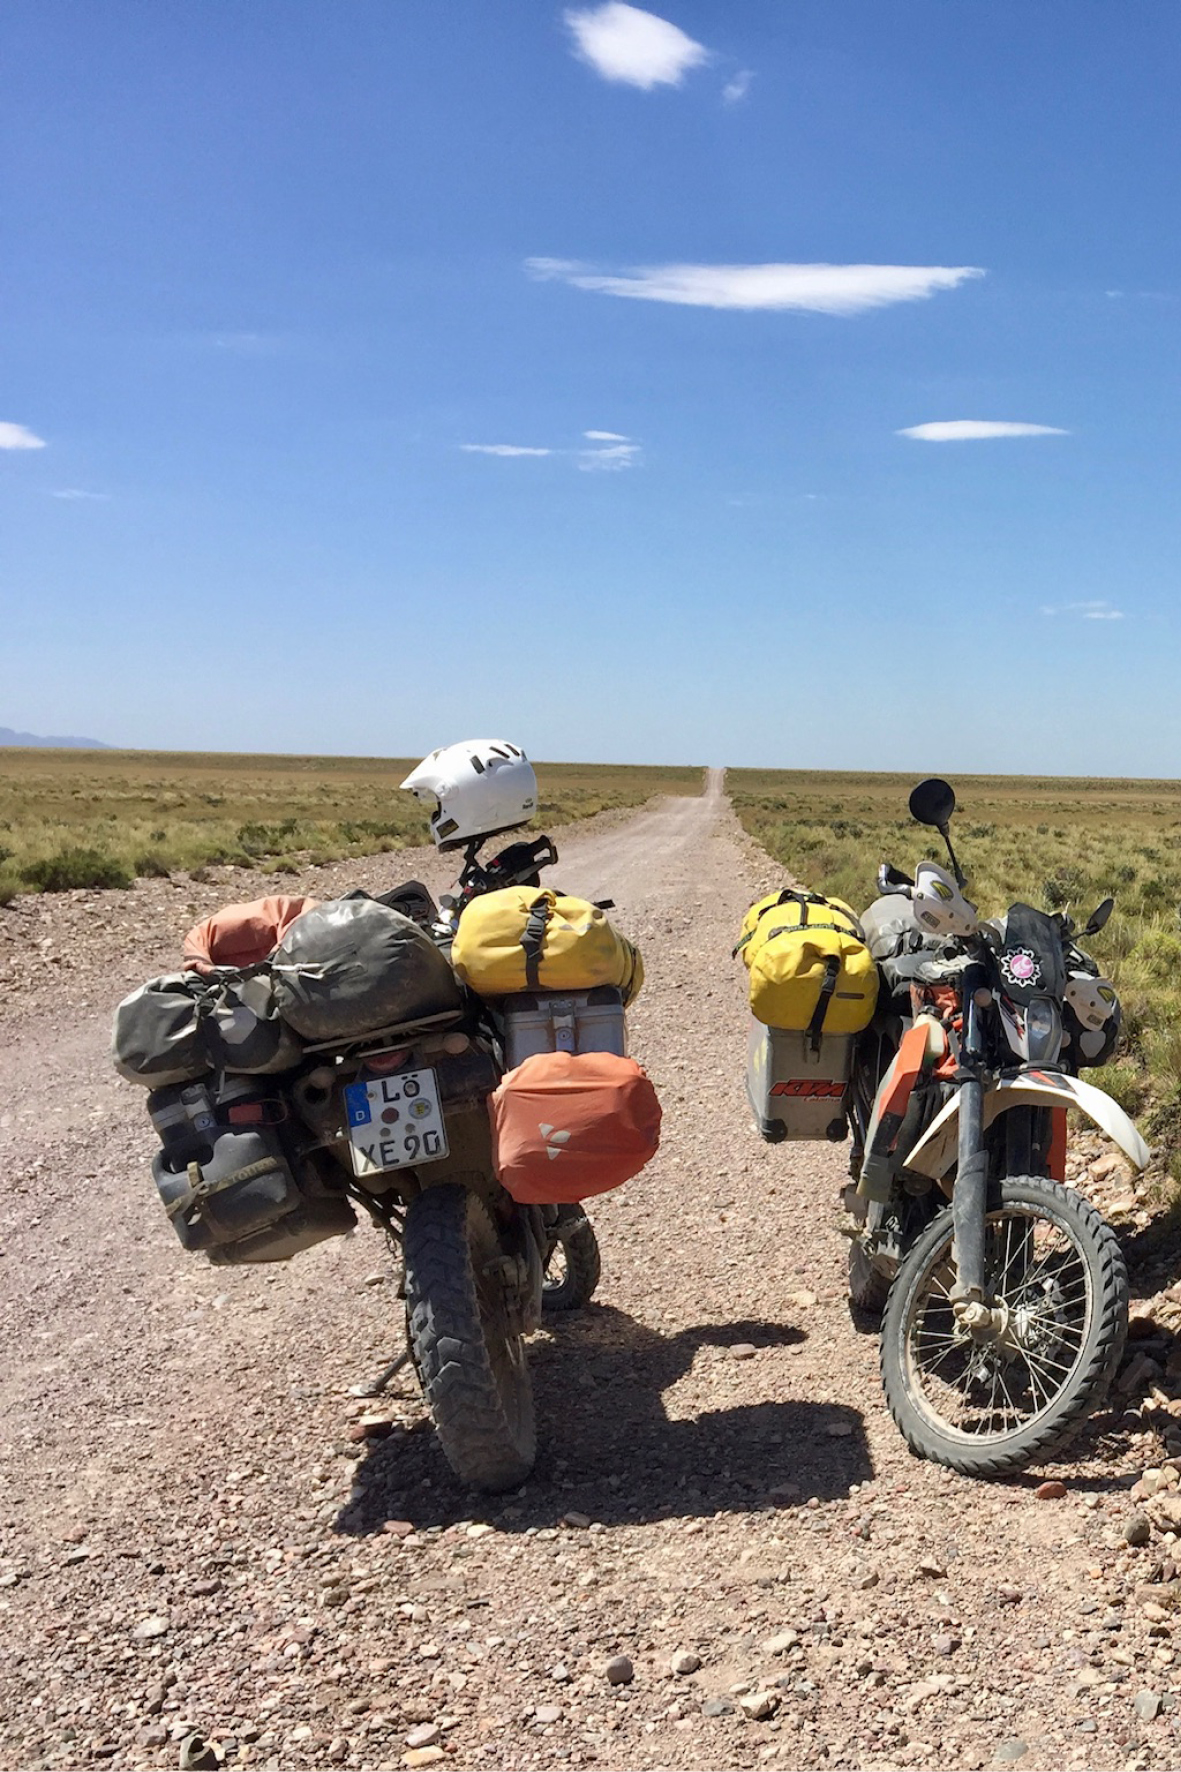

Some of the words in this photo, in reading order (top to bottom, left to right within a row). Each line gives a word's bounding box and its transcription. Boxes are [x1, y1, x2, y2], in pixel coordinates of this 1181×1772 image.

[381, 1074, 421, 1103] LÖ
[767, 1079, 848, 1097] KTM
[355, 1110, 366, 1121] D
[358, 1140, 400, 1173] XE
[404, 1129, 442, 1160] 90
